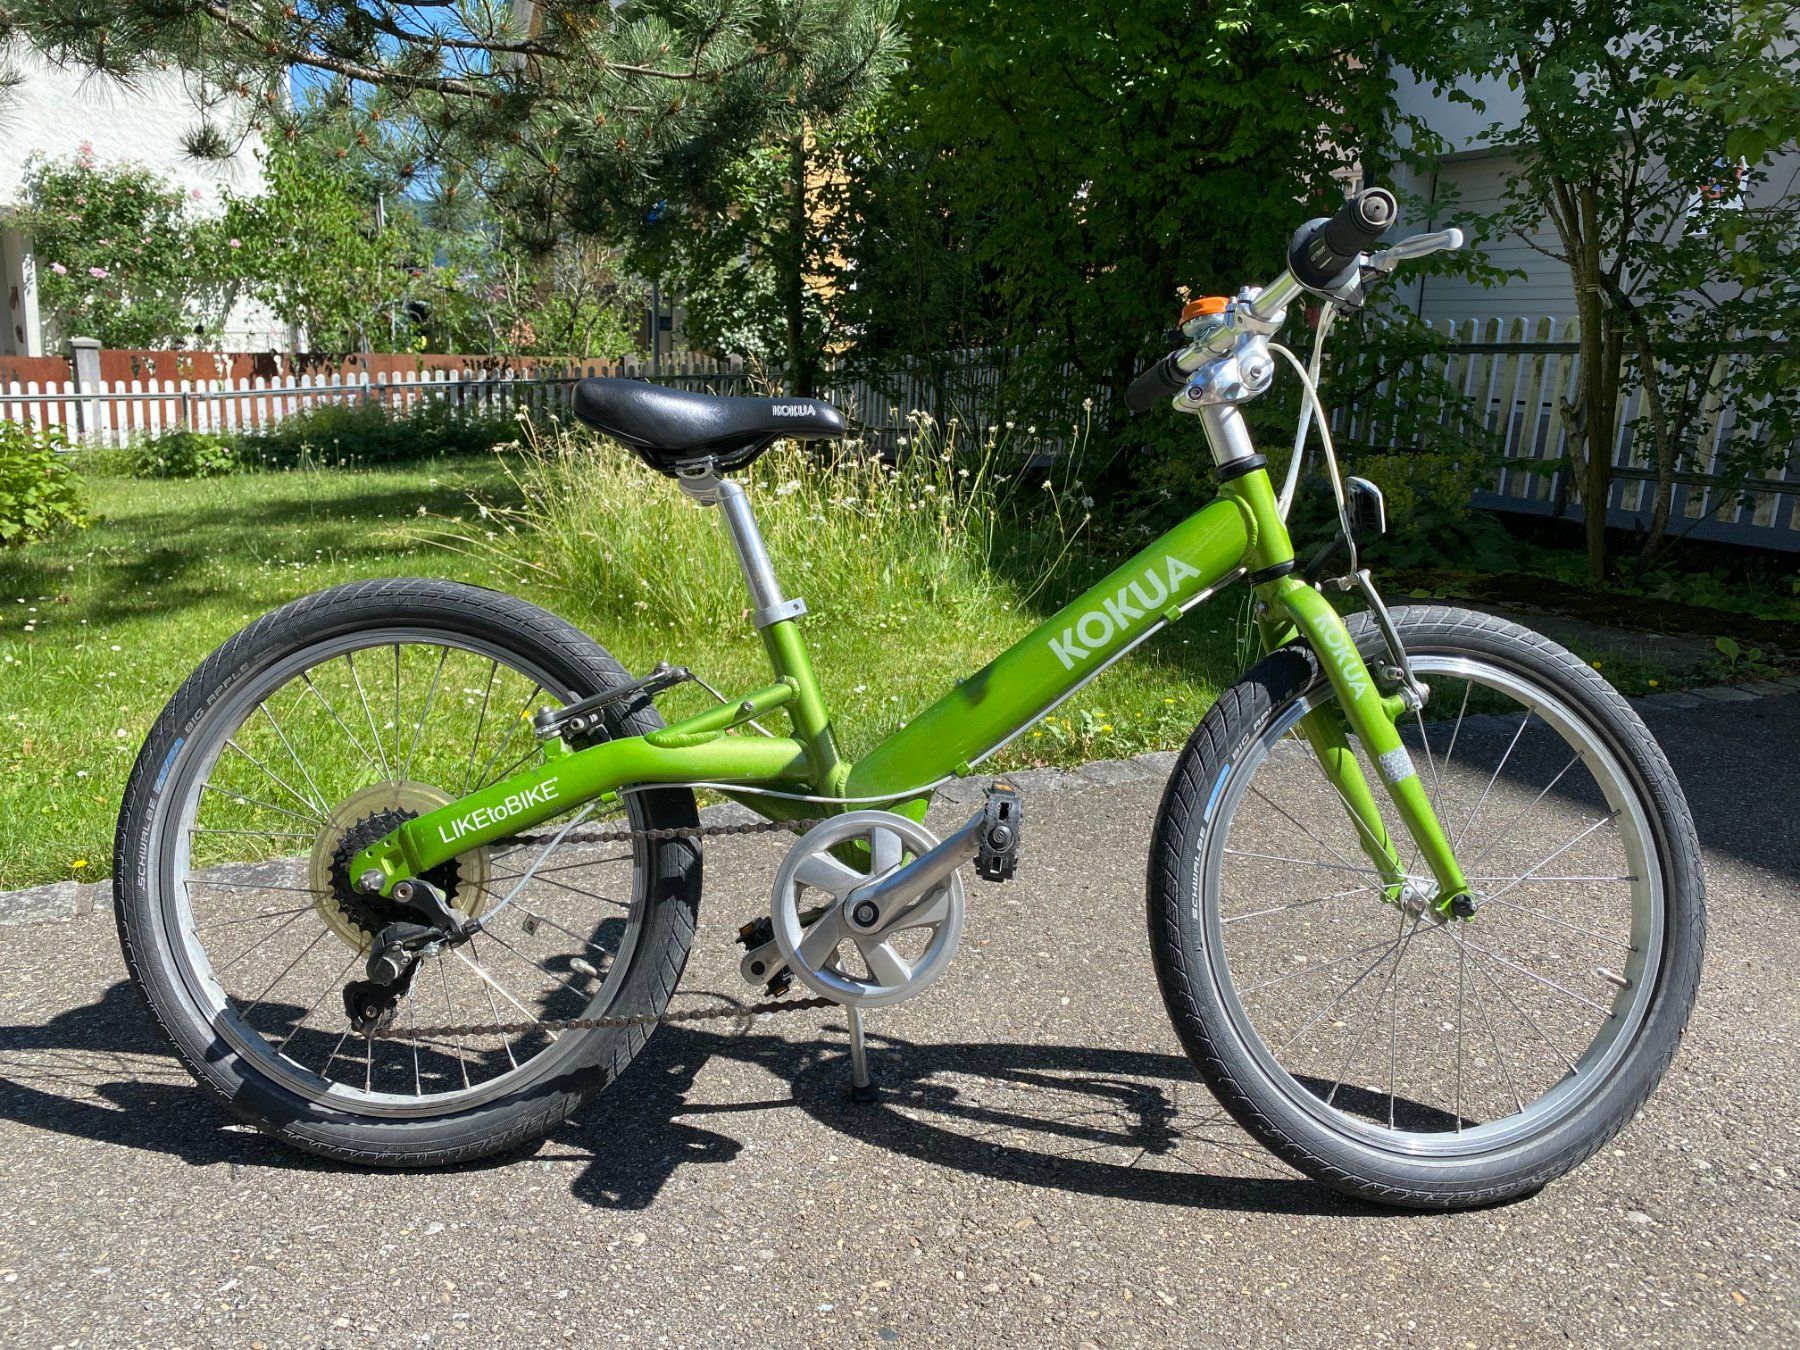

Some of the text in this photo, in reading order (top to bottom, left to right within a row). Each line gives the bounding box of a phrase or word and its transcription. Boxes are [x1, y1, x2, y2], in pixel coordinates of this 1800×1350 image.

[772, 404, 816, 417] KOKUA
[1047, 554, 1202, 671] KOKUA
[184, 662, 250, 734] BIG APPLE
[1313, 613, 1368, 701] KOKUA
[1231, 689, 1293, 761] BIG APPLE
[136, 797, 157, 890] SCHWALBE
[1191, 826, 1207, 920] SCHWALBE
